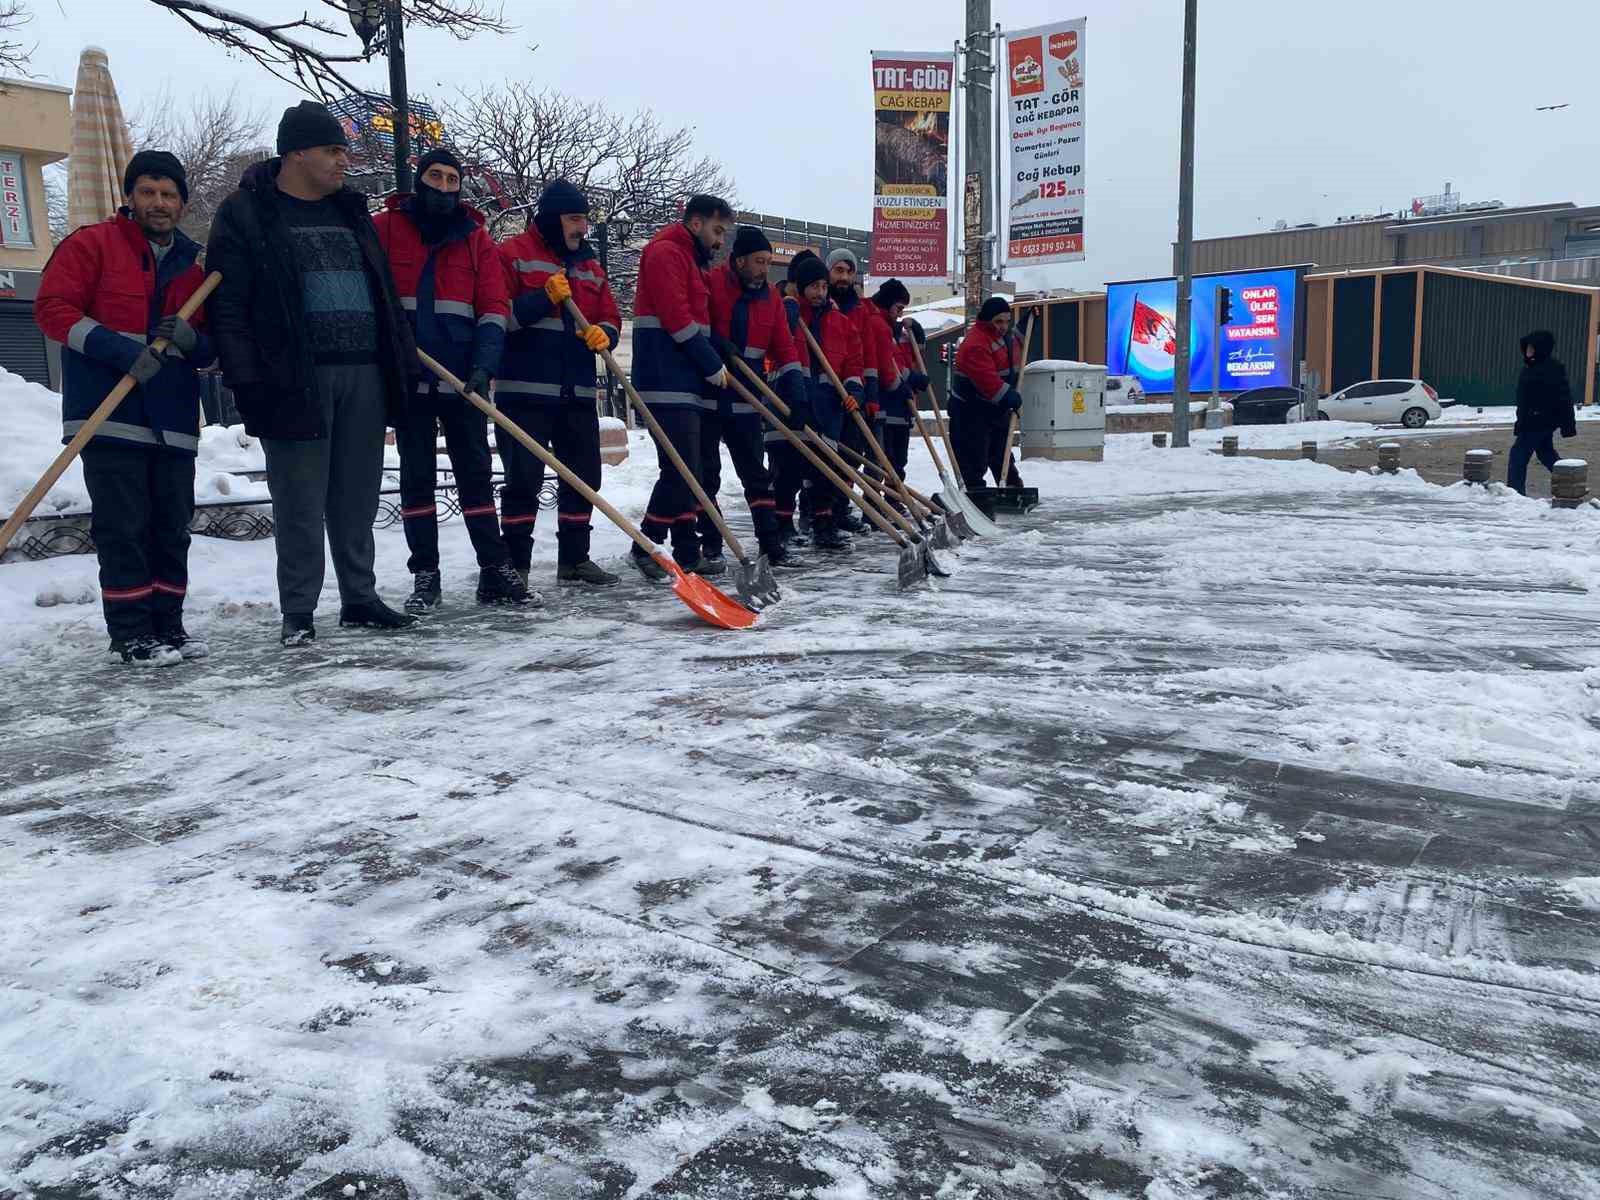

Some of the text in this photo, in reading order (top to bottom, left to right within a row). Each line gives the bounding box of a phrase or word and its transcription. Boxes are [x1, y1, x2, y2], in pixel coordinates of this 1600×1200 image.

[874, 65, 949, 90] TAT-GÖR
[880, 94, 943, 108] CAĞ KEBAP
[1014, 97, 1040, 111] TAT
[1052, 87, 1079, 105] GÖR
[1016, 105, 1079, 124] CAĞ KEBAPDA
[1013, 130, 1034, 140] Ocak
[1049, 121, 1081, 131] Boyunca
[1015, 140, 1052, 153] Cumartesi
[1057, 136, 1080, 145] Pazar
[1034, 149, 1060, 160] Günleri
[1042, 164, 1081, 178] Kebap
[1040, 180, 1067, 199] 125
[876, 197, 901, 207] KUZU
[876, 262, 939, 272] 0533 319 50 24
[1242, 288, 1276, 299] ONLAR
[1255, 314, 1275, 323] SEN
[1228, 326, 1277, 337] VATANSIN.
